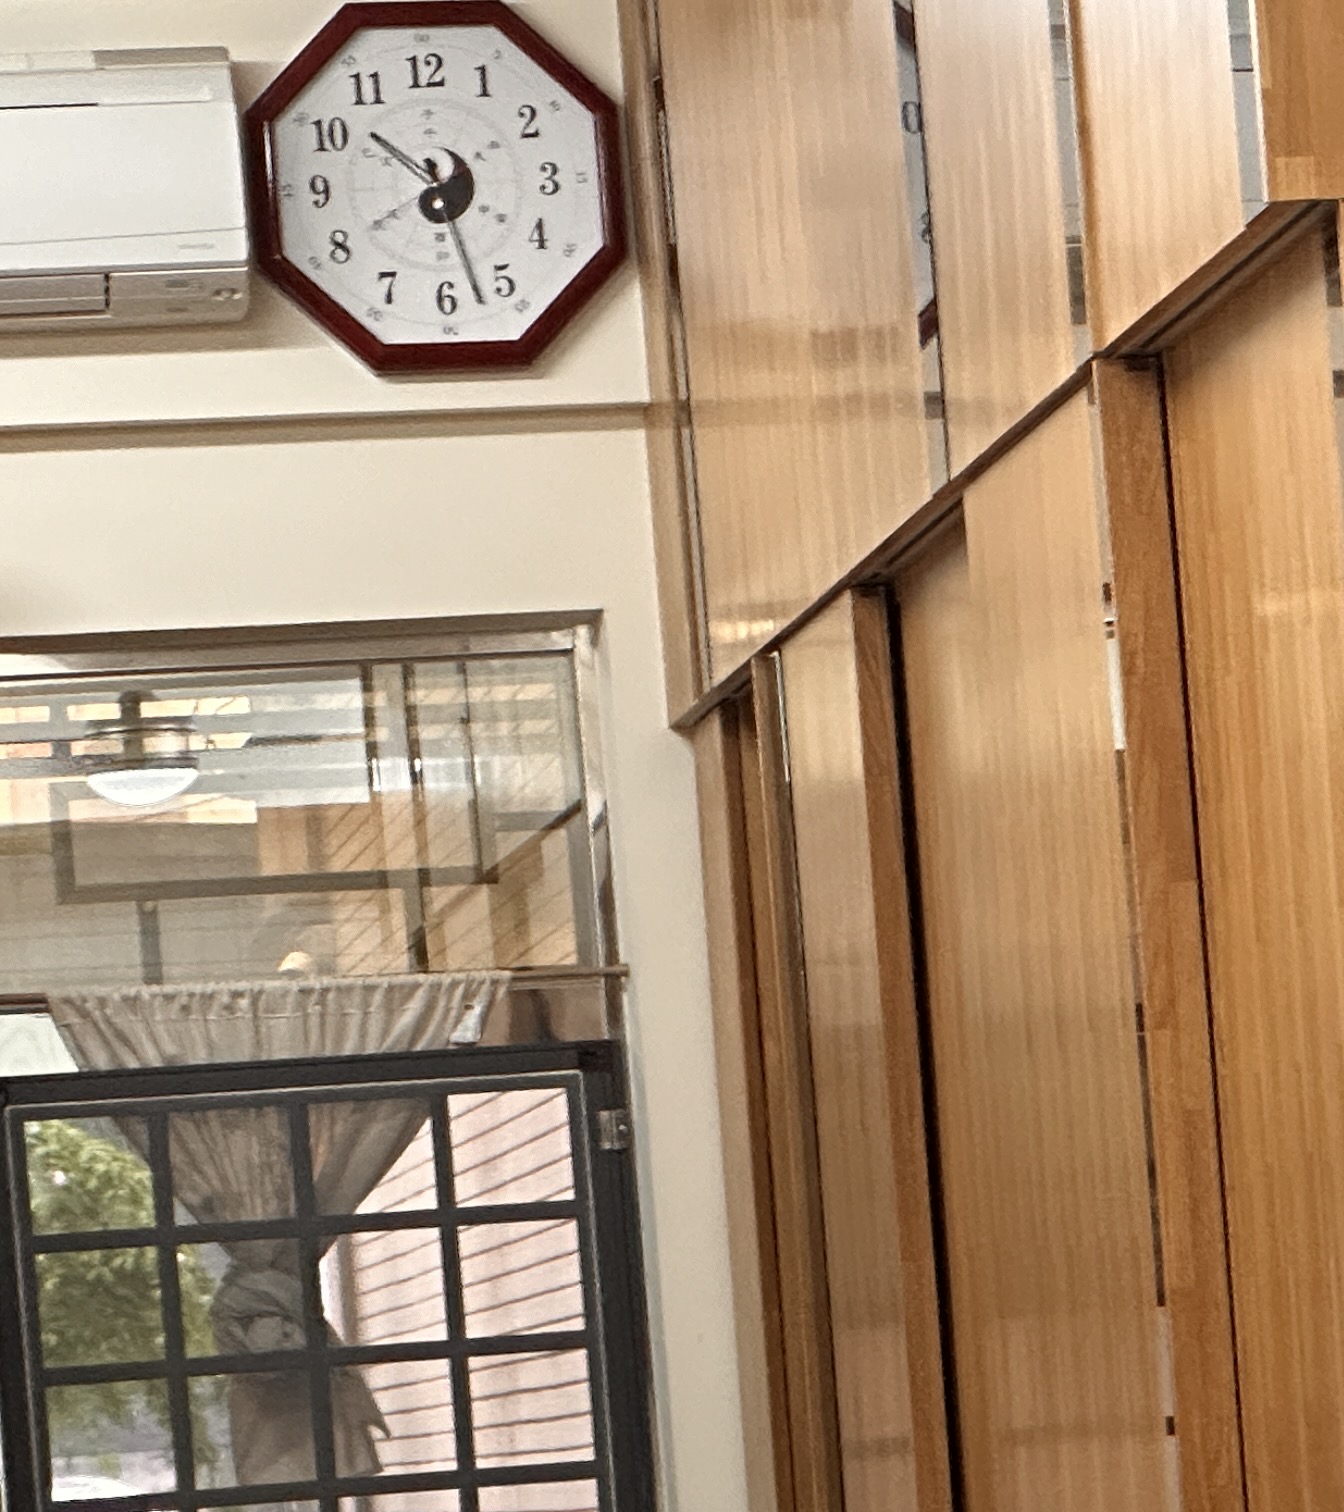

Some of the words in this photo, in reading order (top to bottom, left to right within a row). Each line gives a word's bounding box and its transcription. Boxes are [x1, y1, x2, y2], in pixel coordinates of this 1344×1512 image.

[349, 71, 386, 106] 11
[405, 52, 446, 90] 12
[474, 65, 492, 98] 1
[310, 117, 350, 152] 10
[517, 104, 541, 139] 2
[309, 174, 331, 209] 9
[539, 161, 560, 196] 3
[328, 229, 352, 264] 8
[528, 217, 549, 250] 4
[377, 271, 399, 305] 7
[493, 263, 516, 298] 5
[435, 281, 459, 316] 6
